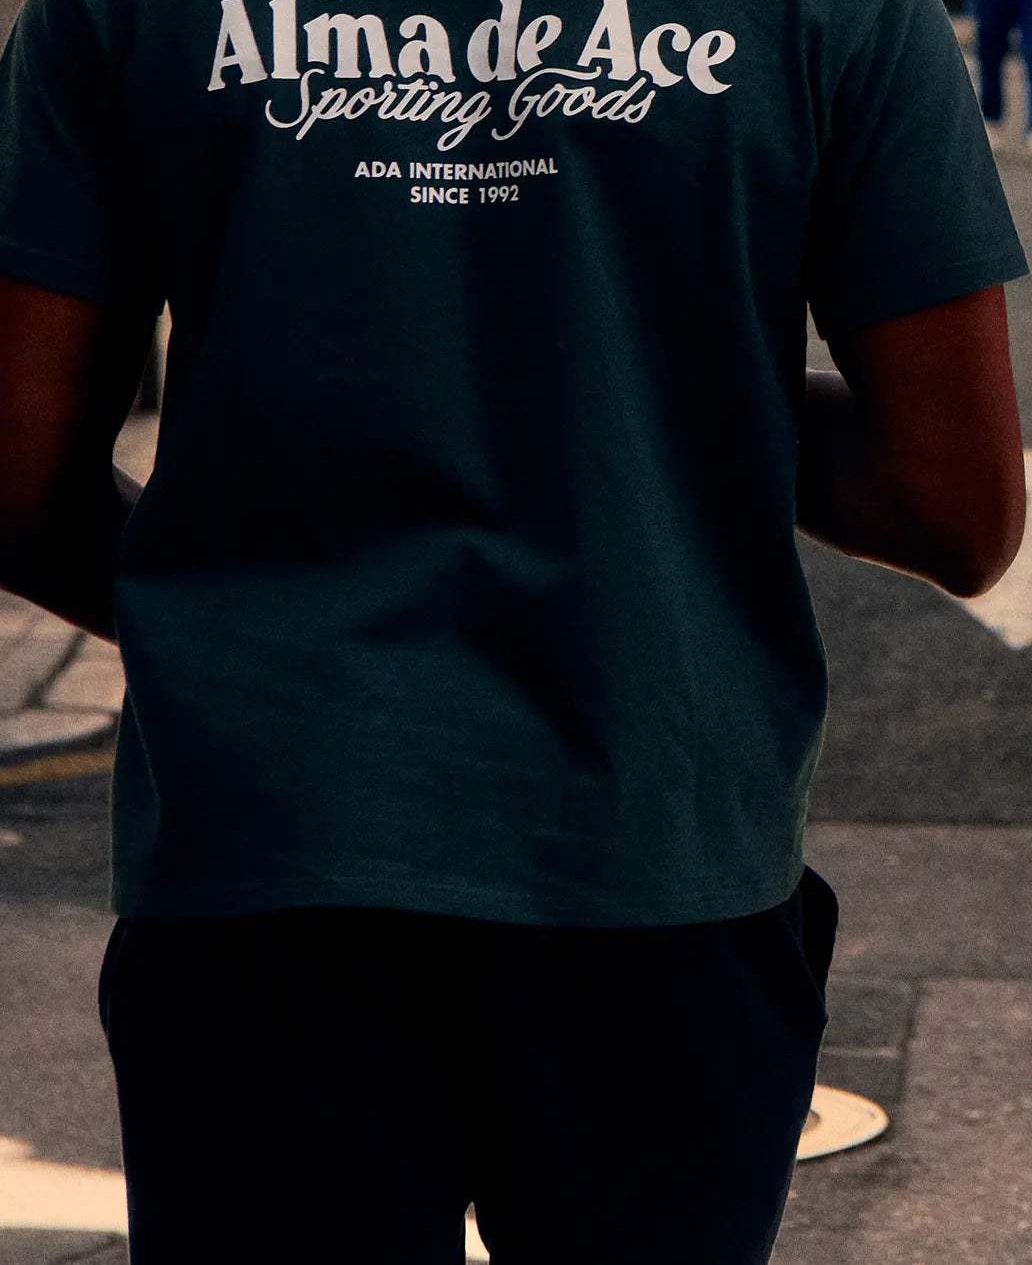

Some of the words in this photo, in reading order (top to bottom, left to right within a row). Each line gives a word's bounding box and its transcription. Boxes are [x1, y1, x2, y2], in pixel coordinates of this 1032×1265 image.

[265, 68, 493, 152] Sporting
[491, 65, 656, 141] Goods
[354, 161, 402, 179] ADA
[409, 157, 559, 181] INTERNATIONAL
[410, 185, 470, 205] SINCE
[479, 184, 520, 204] 1992
